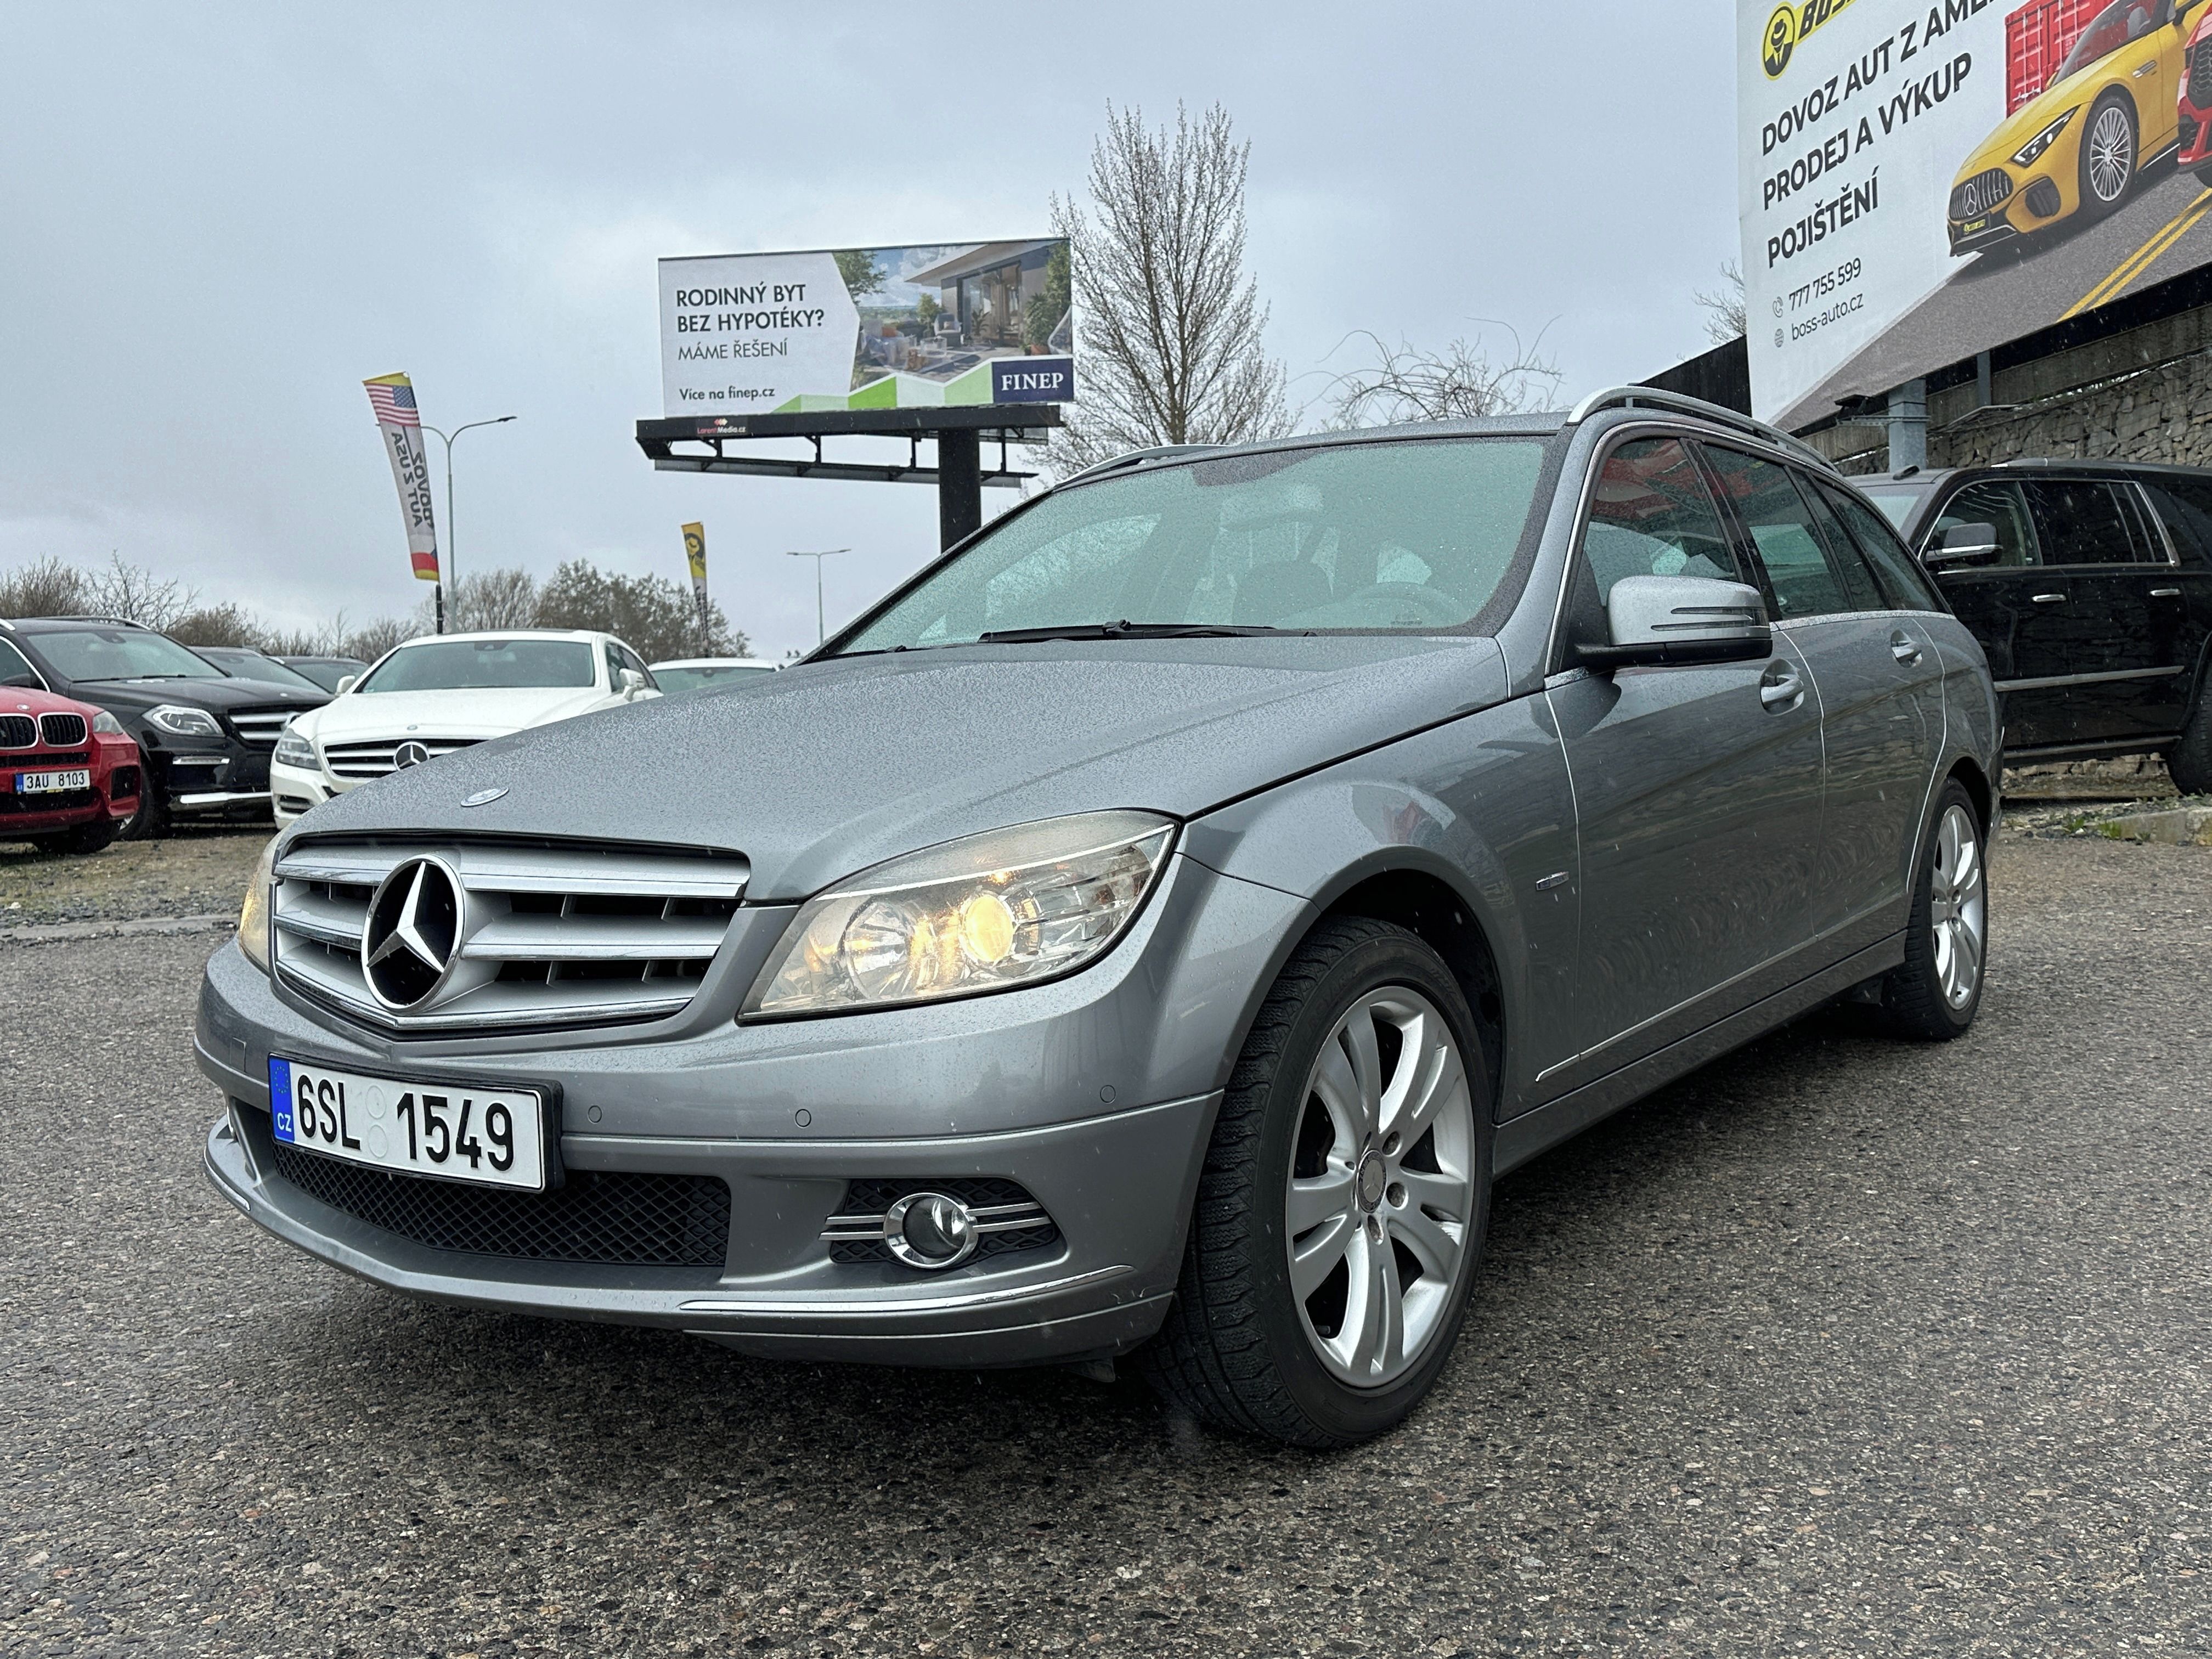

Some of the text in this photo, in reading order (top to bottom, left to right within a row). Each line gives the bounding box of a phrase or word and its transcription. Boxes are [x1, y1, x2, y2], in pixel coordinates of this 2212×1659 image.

[1798, 0, 1852, 40] BO
[1763, 75, 1839, 156] DOVOZ
[1844, 36, 1894, 100] AUT
[1900, 21, 1917, 63] Z
[1763, 52, 1972, 211] PRODEJ A VÝKUP
[1768, 165, 1880, 269] POJIŠTĚNÍ
[676, 281, 806, 307] RODINNÝ BYT
[1789, 257, 1861, 311] 777 755 599
[678, 306, 824, 332] BEZ HYPOTÉKY?
[1792, 293, 1864, 341] boss-auto.cz
[678, 337, 788, 360] MÁME ŘEŠENÍ
[680, 386, 775, 401] Více na finep.cz
[1001, 372, 1064, 391] FINEP
[26, 774, 49, 789] 3AU
[58, 772, 84, 787] 8103
[277, 1113, 292, 1132] CZ
[297, 1074, 514, 1171] 6SL 1549
